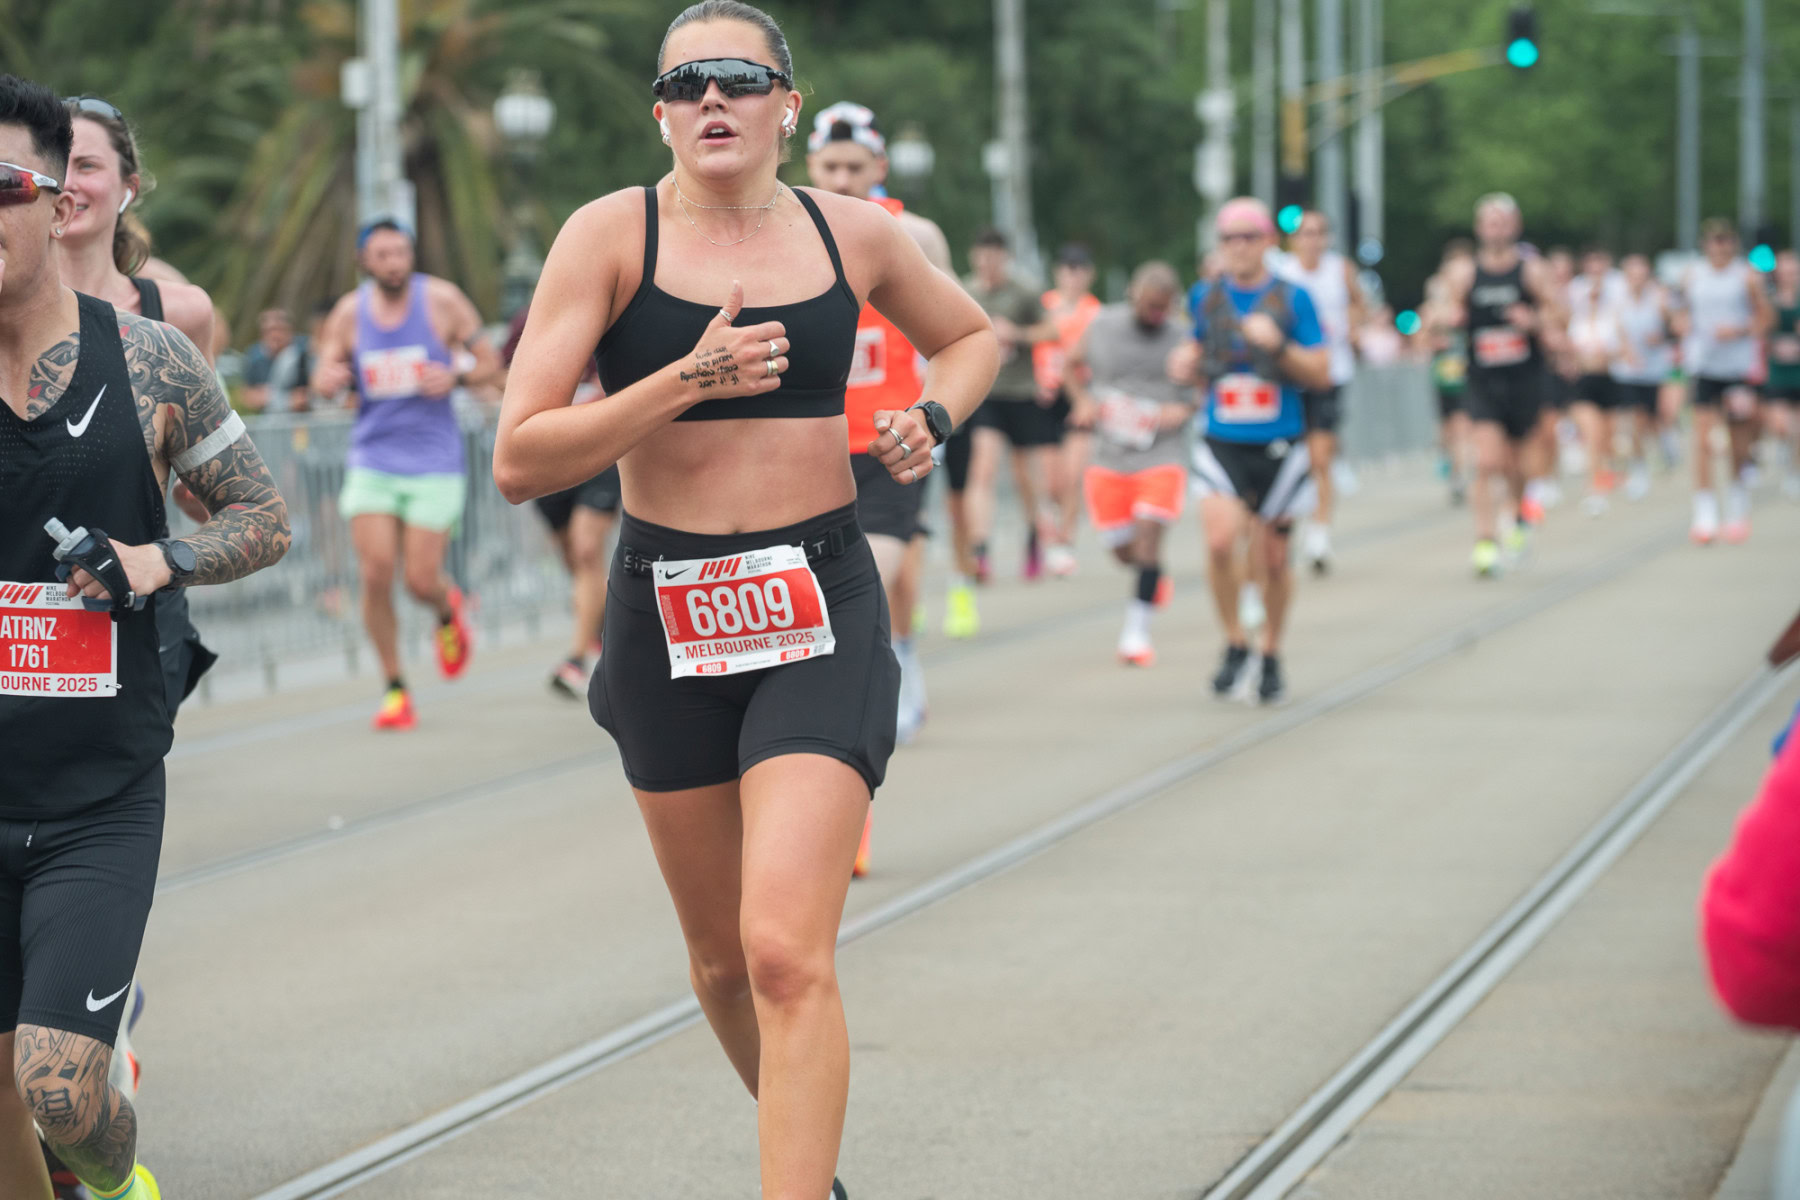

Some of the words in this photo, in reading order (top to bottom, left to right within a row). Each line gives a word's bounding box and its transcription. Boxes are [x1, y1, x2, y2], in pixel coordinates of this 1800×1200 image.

[686, 577, 795, 637] 6809
[0, 615, 57, 641] ATRNZ
[8, 643, 49, 669] 1761
[685, 636, 773, 660] MELBOURNE
[776, 631, 815, 647] 2025
[785, 649, 805, 660] 6809
[701, 662, 723, 674] 6809
[1, 675, 51, 692] OURNE
[57, 677, 98, 692] 2025
